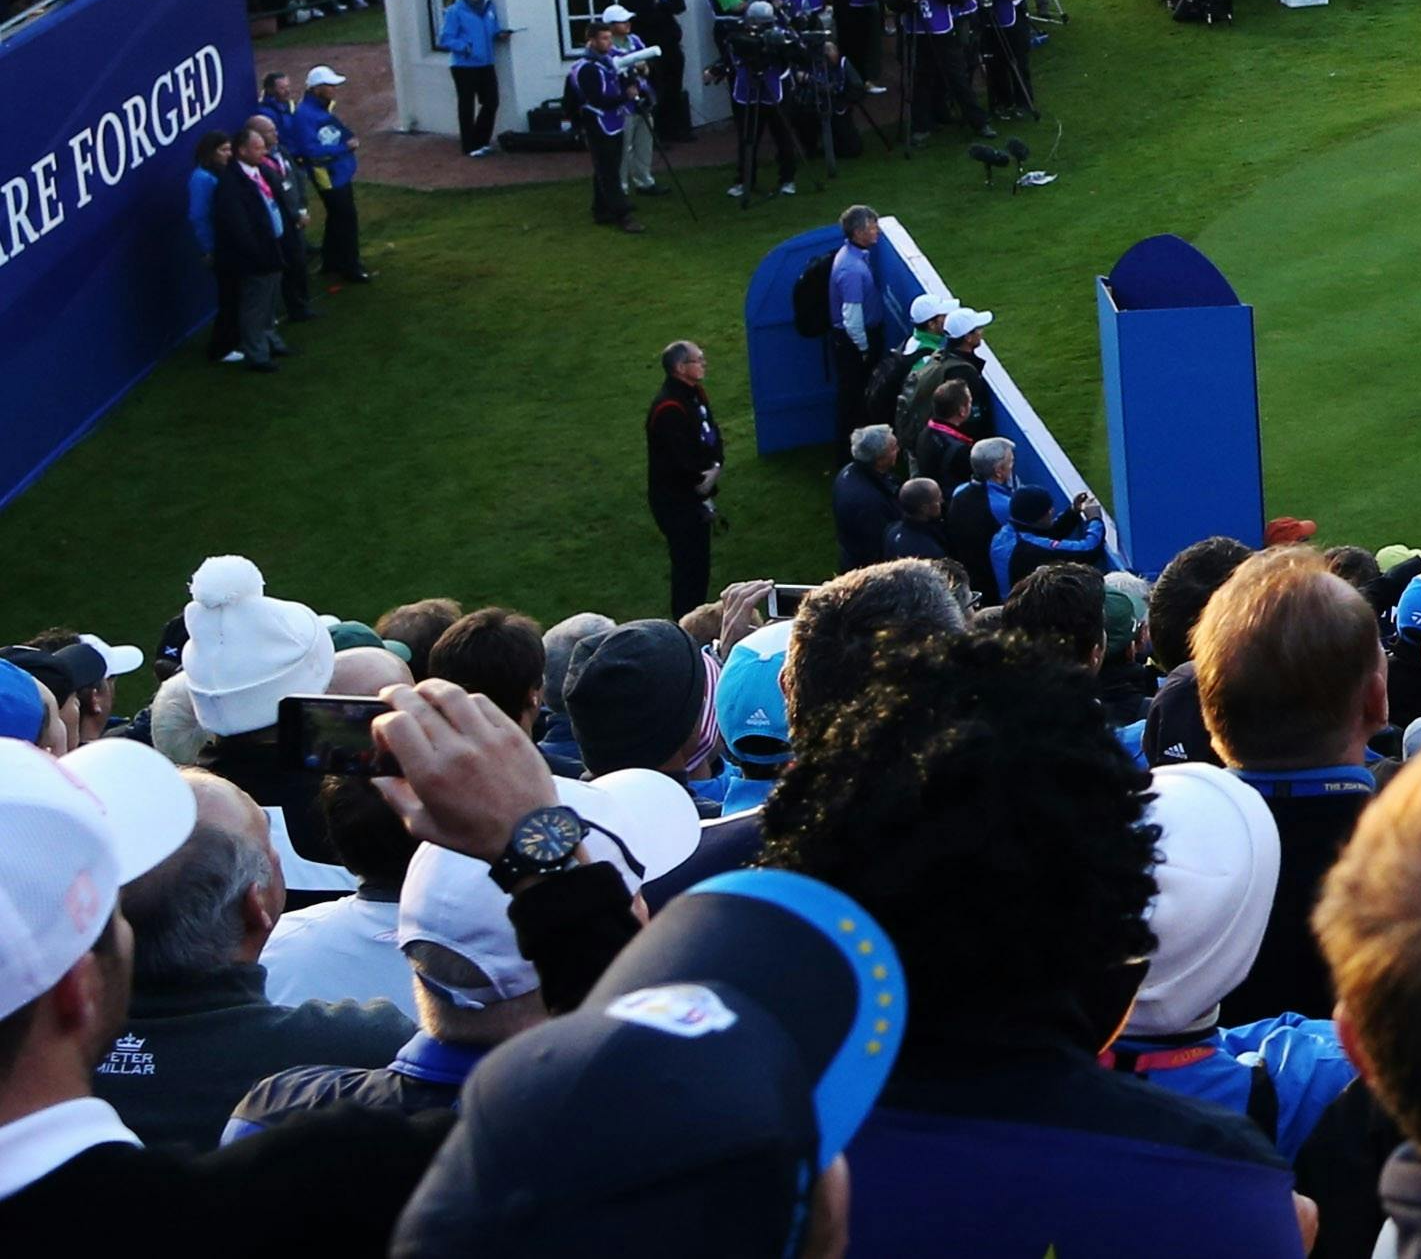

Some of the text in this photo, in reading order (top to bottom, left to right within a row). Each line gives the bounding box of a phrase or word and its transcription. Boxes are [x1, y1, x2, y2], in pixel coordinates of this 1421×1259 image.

[0, 44, 223, 267] RE FORGED
[105, 1051, 154, 1063] ETER
